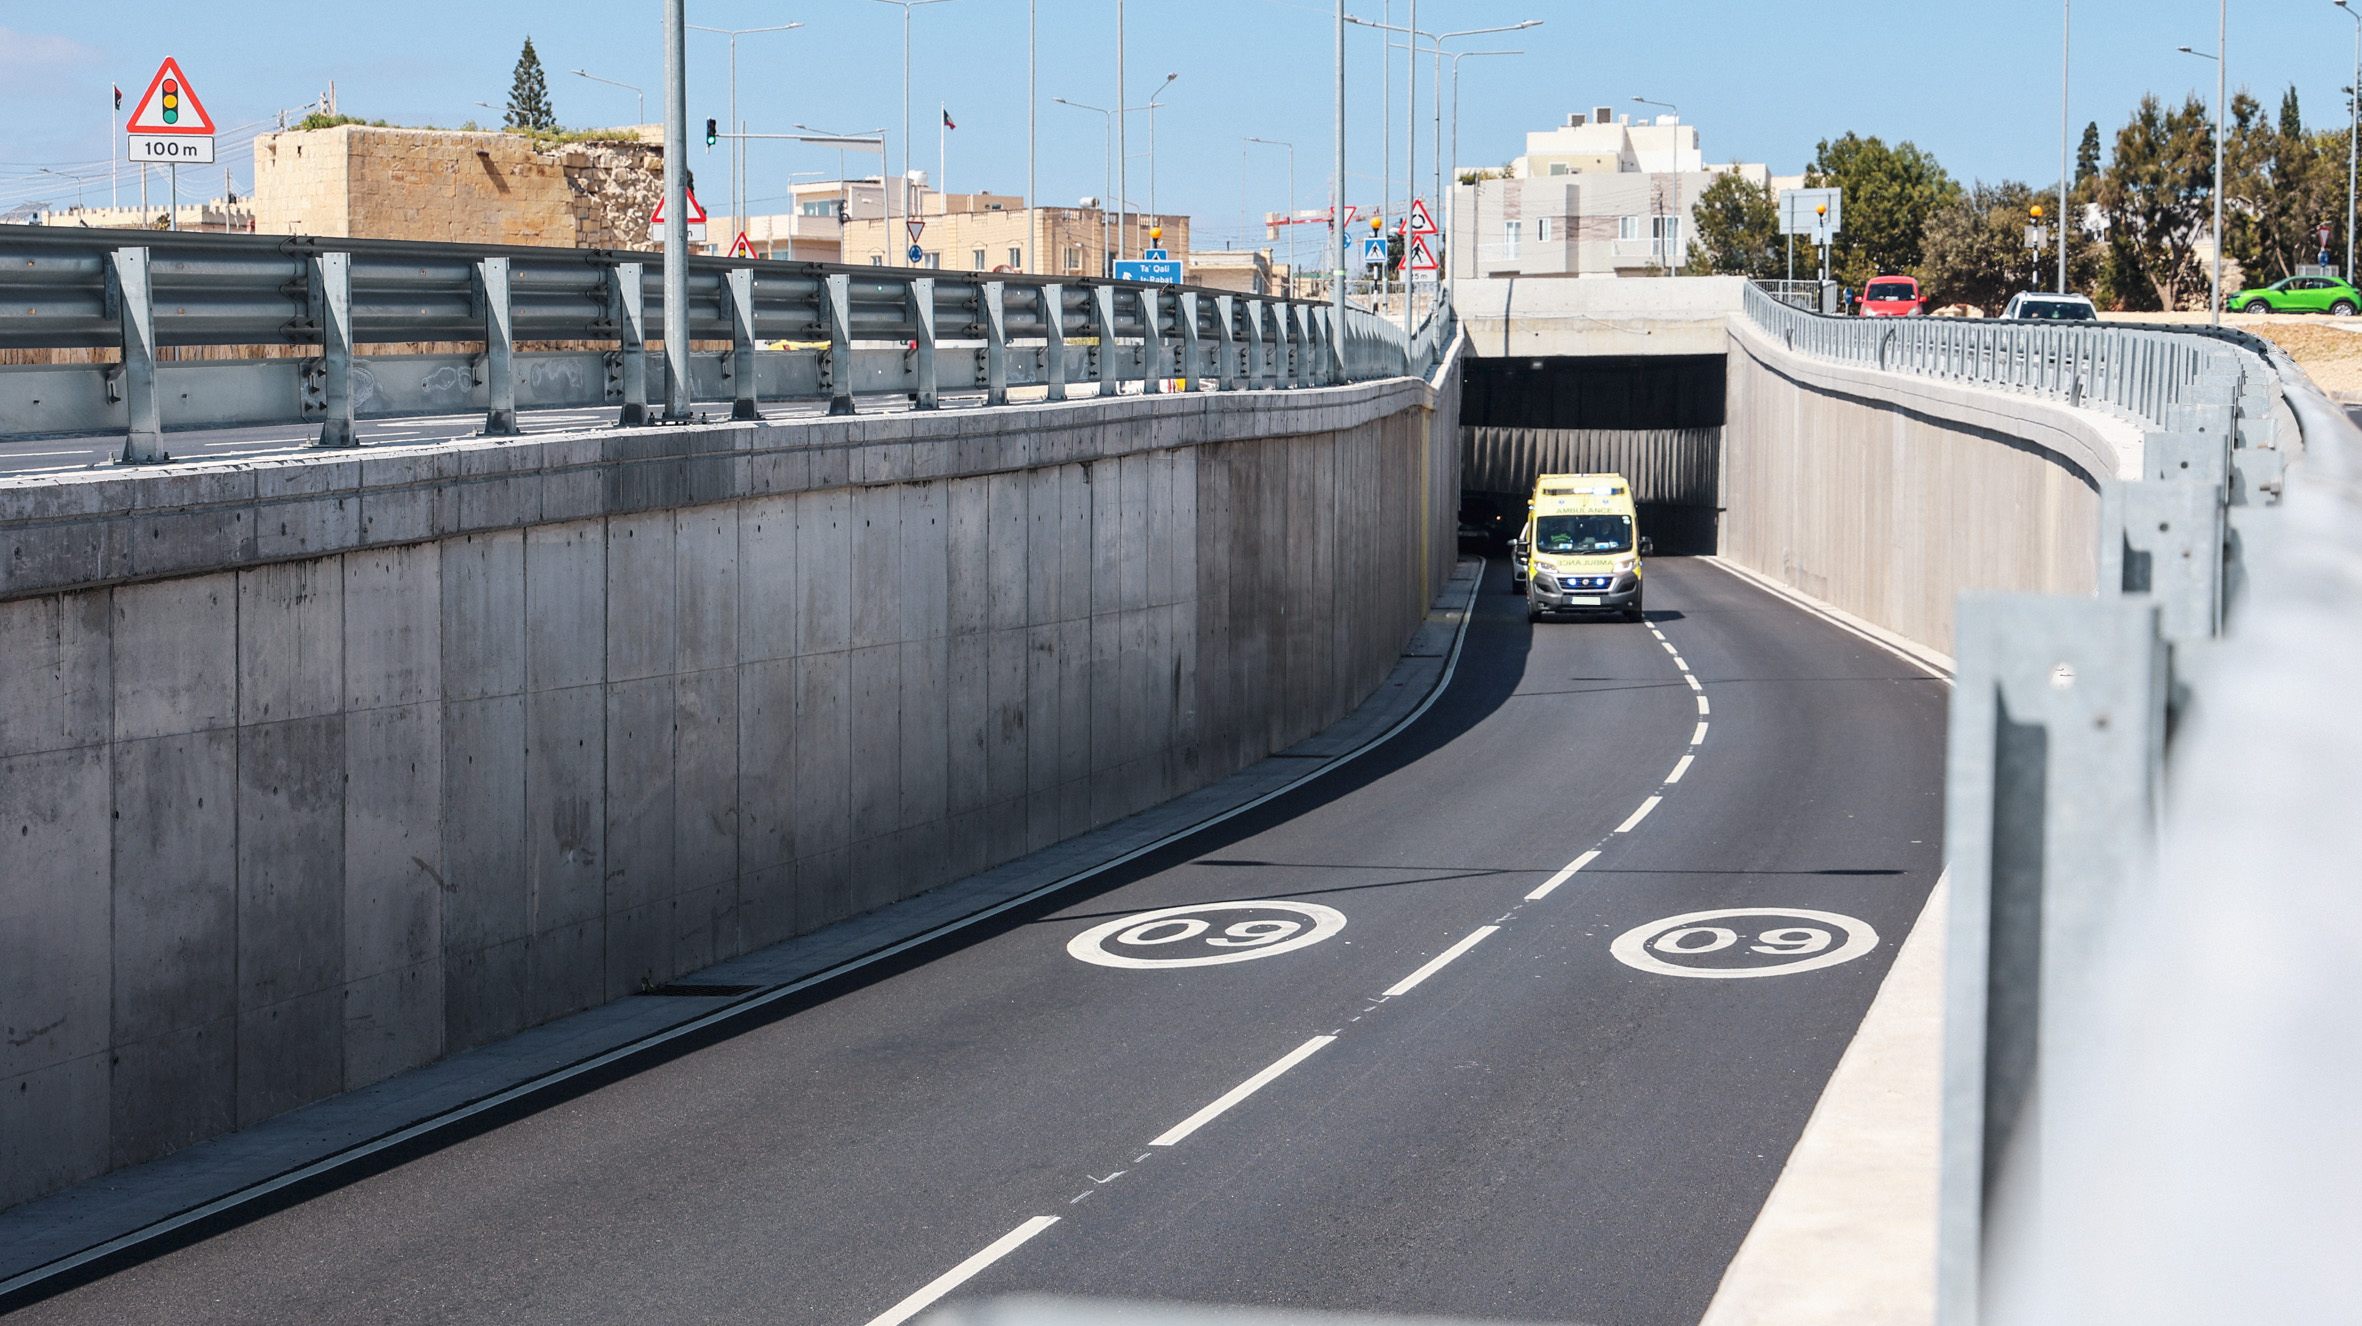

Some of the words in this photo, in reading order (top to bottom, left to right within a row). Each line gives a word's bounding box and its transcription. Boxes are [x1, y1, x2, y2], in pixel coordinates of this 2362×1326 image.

[145, 141, 179, 156] 100
[183, 145, 198, 156] m
[1153, 264, 1170, 273] Qali
